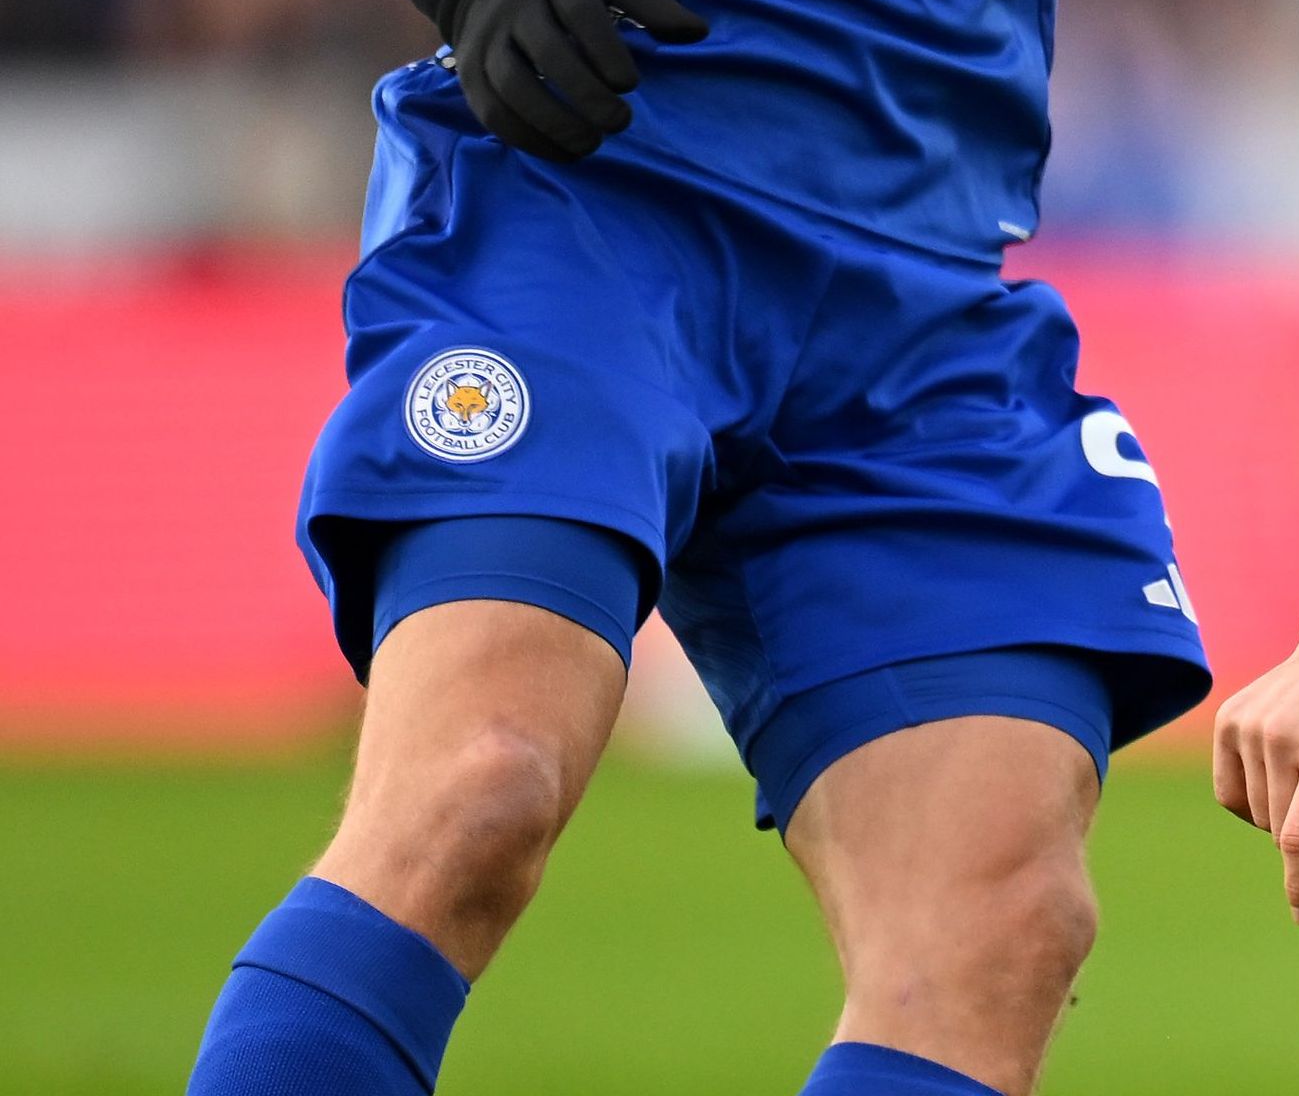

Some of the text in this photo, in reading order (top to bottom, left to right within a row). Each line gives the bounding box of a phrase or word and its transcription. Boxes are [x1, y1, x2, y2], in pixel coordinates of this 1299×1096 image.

[418, 359, 518, 406] LEICESTER CITY
[416, 408, 515, 450] FOOTBALL CLUB
